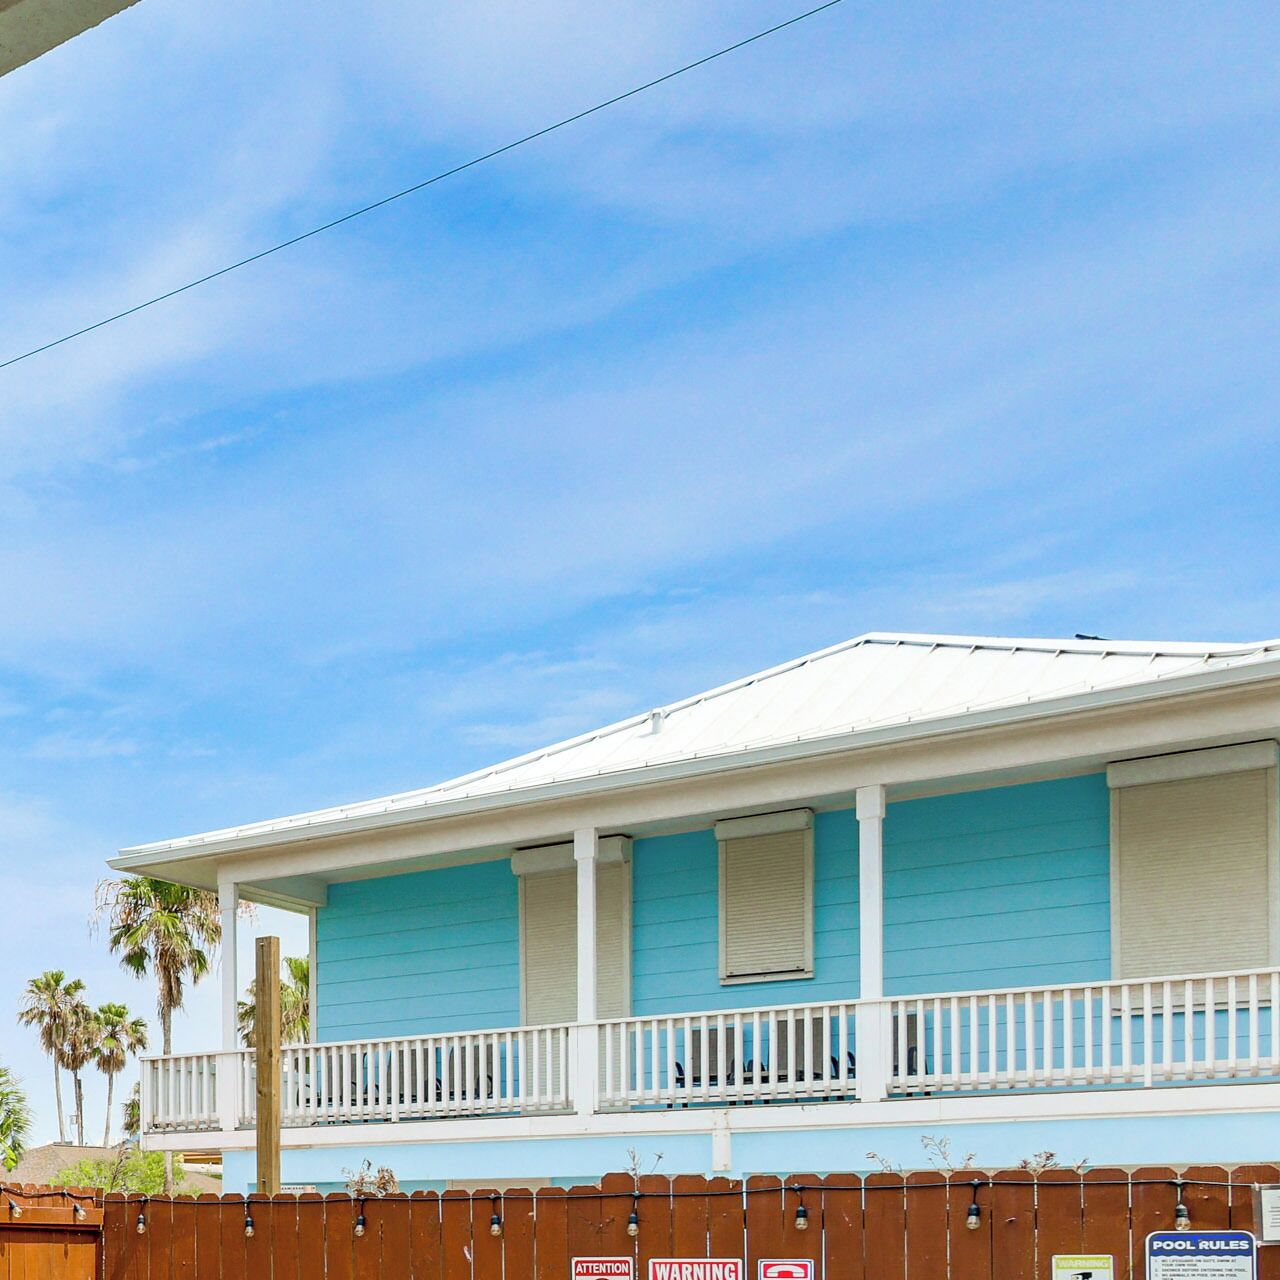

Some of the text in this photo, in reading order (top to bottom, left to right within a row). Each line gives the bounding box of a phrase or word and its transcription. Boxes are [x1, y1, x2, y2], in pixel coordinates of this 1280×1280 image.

[1153, 1240, 1249, 1250] POOL RULES
[576, 1263, 629, 1274] ATTENTION
